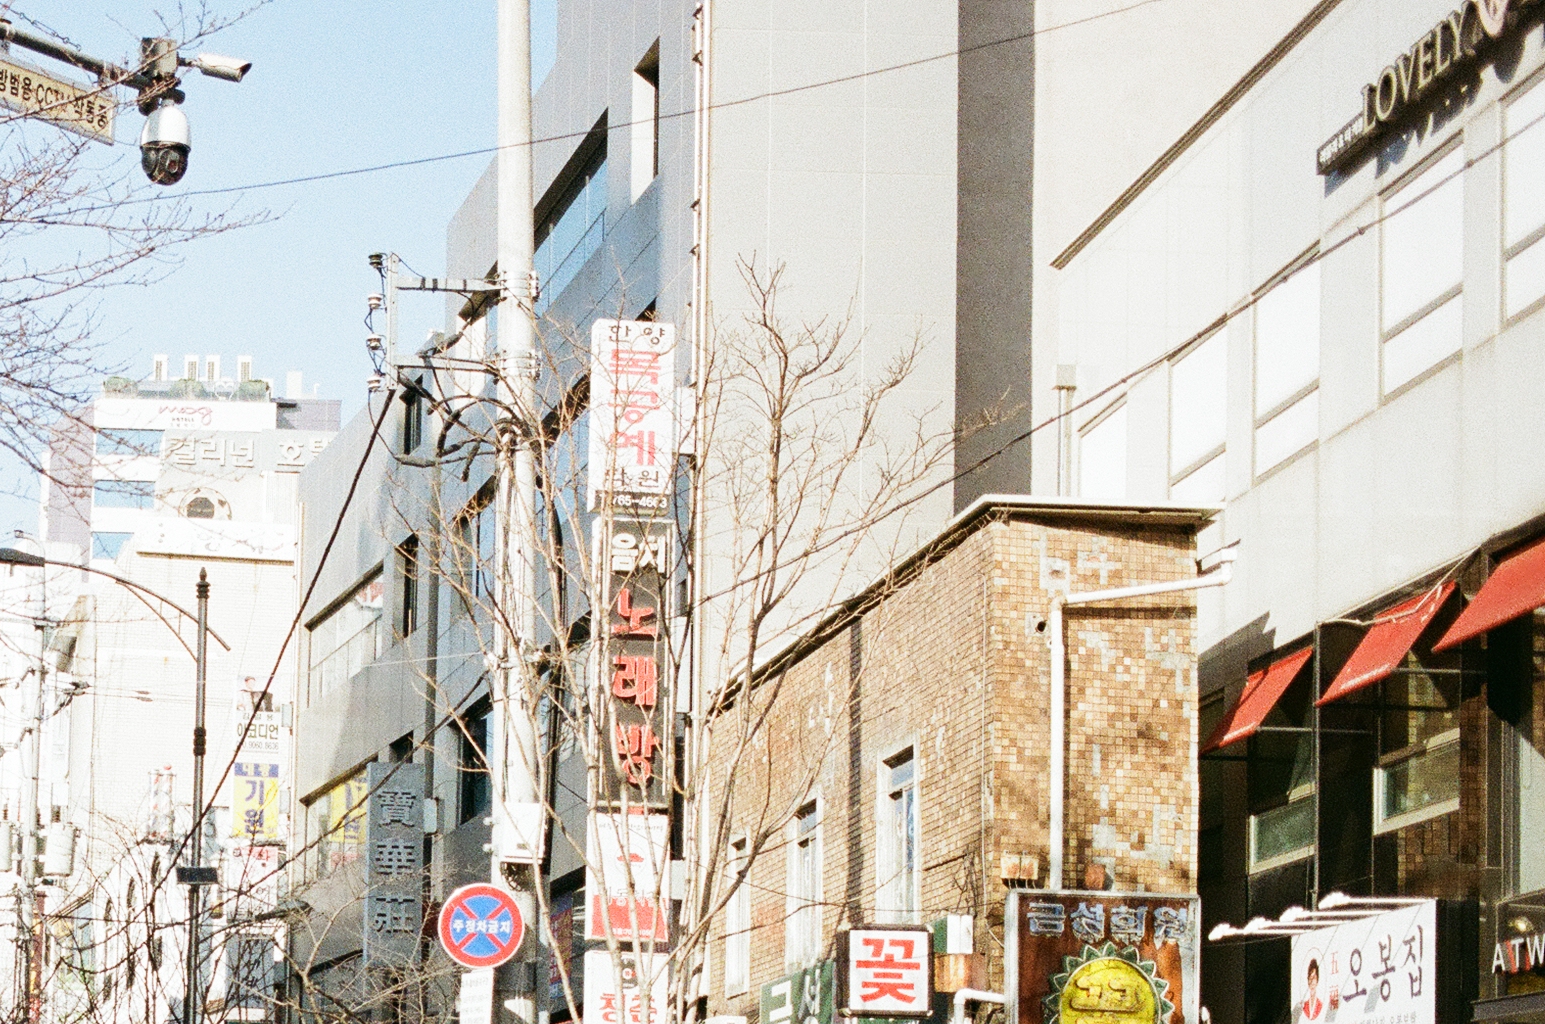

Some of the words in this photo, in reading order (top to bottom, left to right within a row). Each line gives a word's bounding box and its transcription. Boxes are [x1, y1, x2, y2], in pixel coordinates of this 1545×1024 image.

[1361, 2, 1469, 137] LOVELY
[609, 325, 666, 346] 한양
[608, 348, 661, 467] 목공예
[611, 587, 661, 785] 노래방
[244, 780, 265, 835] 기원
[452, 919, 511, 934] 주정차금지
[1492, 943, 1506, 974] A
[855, 937, 921, 1004] 꽃
[1342, 924, 1424, 1003] 오봉집
